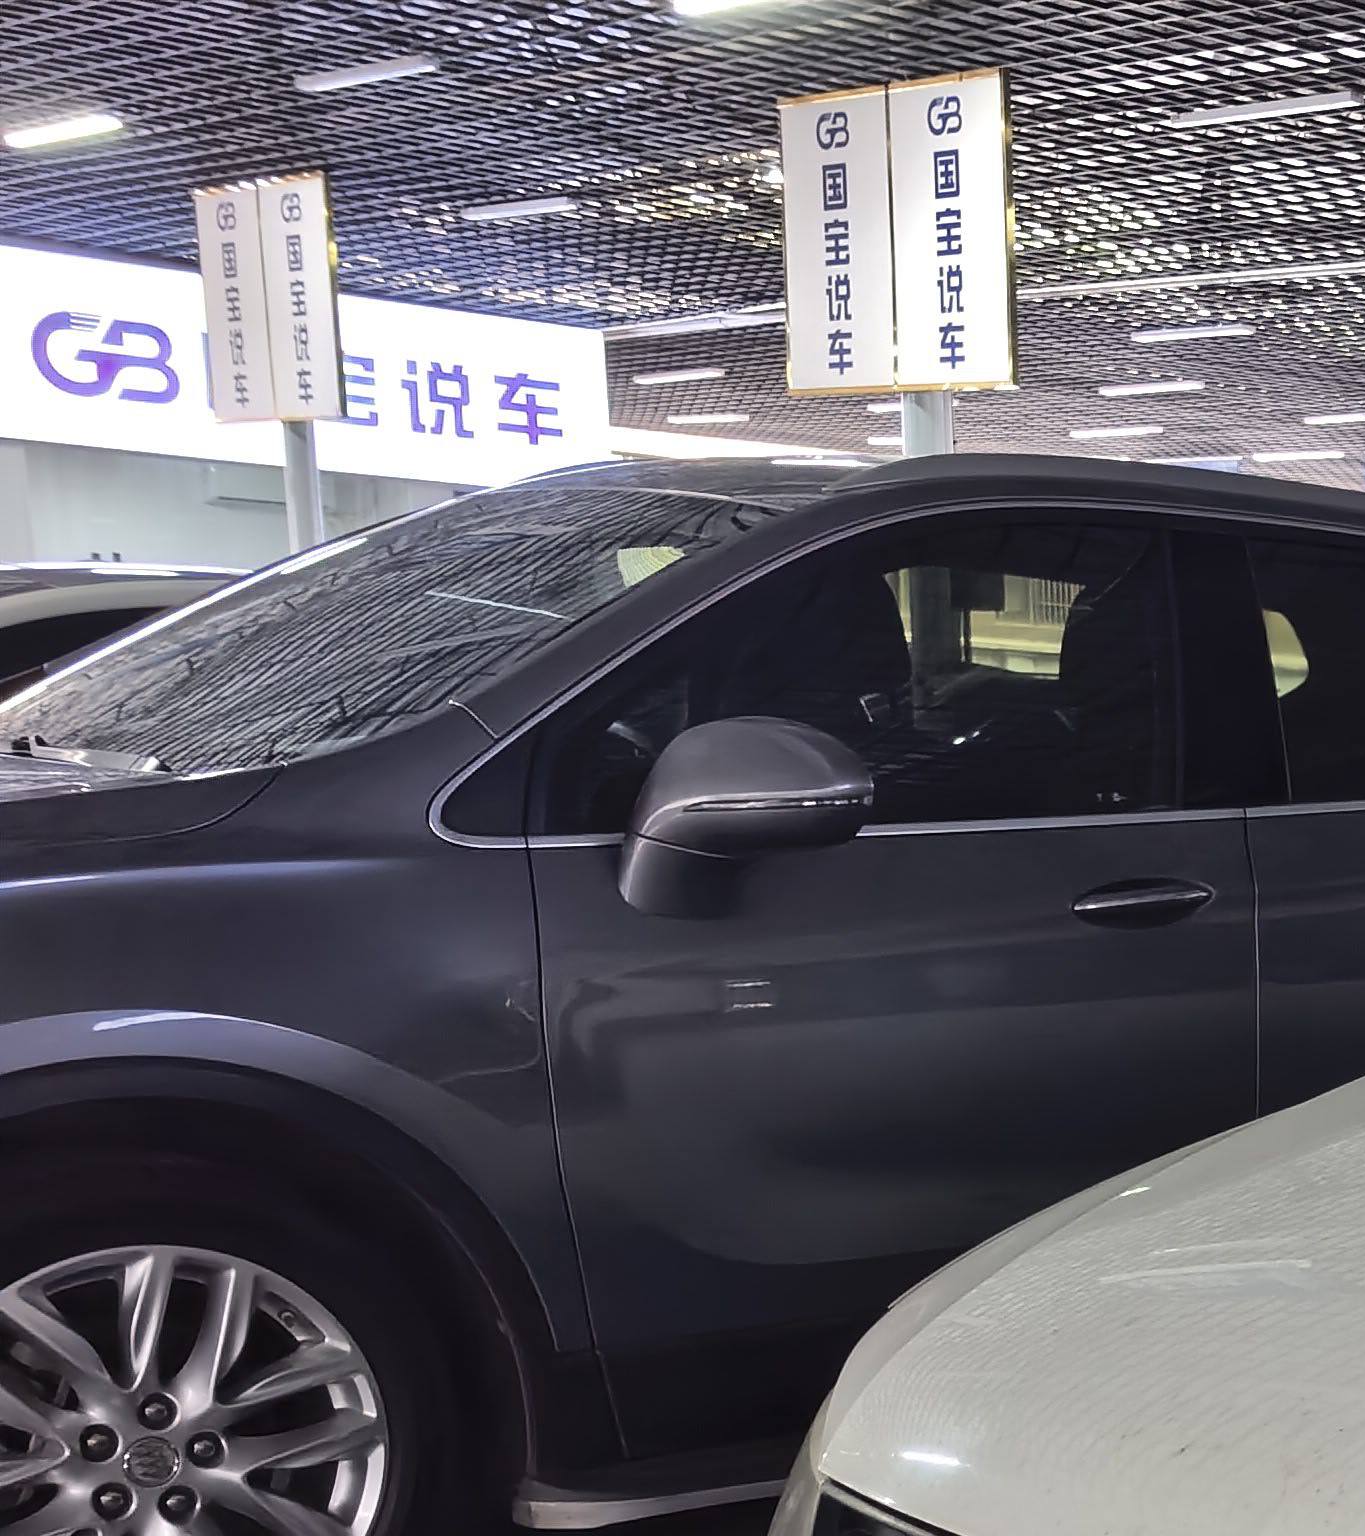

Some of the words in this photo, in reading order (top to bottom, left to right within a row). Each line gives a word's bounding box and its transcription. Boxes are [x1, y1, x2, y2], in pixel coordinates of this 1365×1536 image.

[31, 311, 180, 403] GB
[822, 162, 853, 376] 国宝说车
[933, 149, 966, 370] 国宝说车
